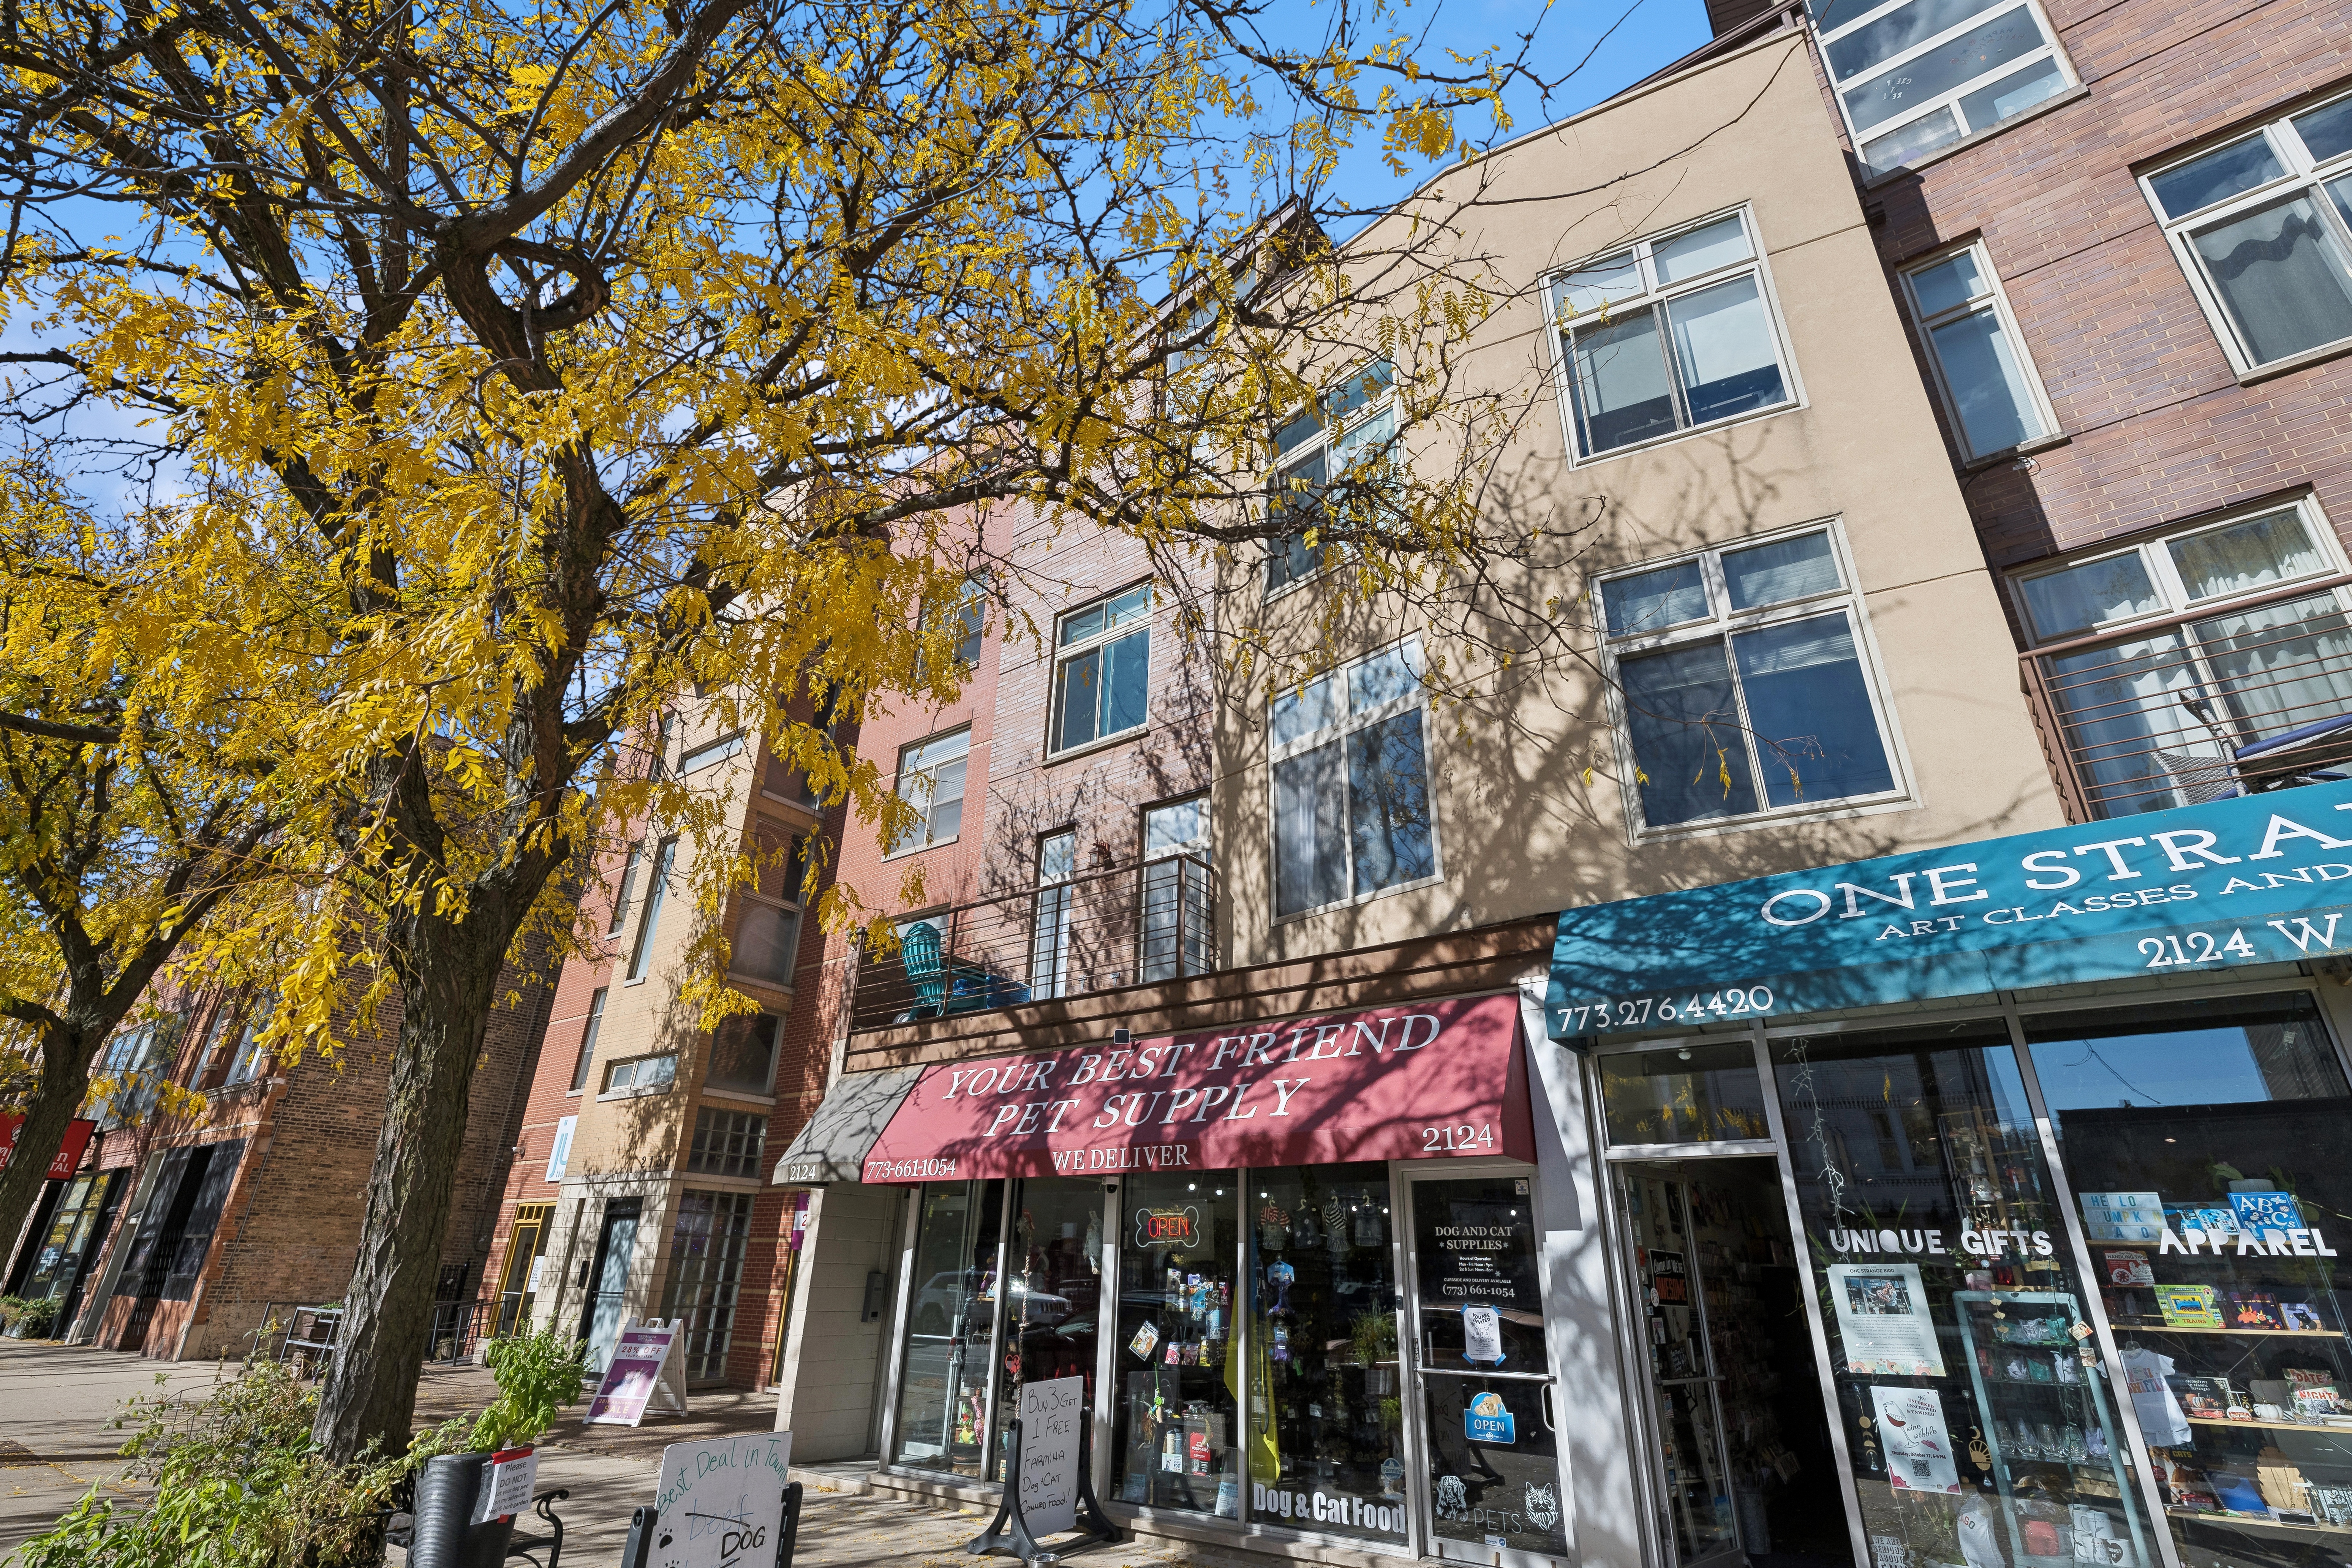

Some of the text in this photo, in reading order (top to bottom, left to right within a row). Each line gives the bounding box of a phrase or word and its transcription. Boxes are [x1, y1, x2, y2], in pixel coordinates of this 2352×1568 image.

[1761, 804, 2352, 926] ONE STRA
[1876, 863, 2352, 941] ART CLASSES AND
[2137, 913, 2343, 968] 2124 W
[1557, 985, 1773, 1033] 773.276.4420
[942, 1014, 1440, 1099] YOUR BEST FRIEND
[983, 1078, 1311, 1138] PET SUPPLY
[1422, 1124, 1494, 1152] 2124
[640, 1154, 671, 1169] 2130
[1052, 1144, 1190, 1171] WE DELIVER
[789, 1163, 816, 1181] 2124
[867, 1158, 956, 1181] 773-661-1054
[2090, 1195, 2136, 1207] HELO
[1149, 1217, 1189, 1237] OPEN
[1435, 1227, 1513, 1236] DOG AND CAT
[1447, 1240, 1502, 1250] SUPPLIES
[1829, 1229, 2053, 1256] UNIQUE GIFTS
[2159, 1228, 2337, 1257] APPAREL
[1654, 1259, 1666, 1273] Come
[1666, 1257, 1671, 1270] in
[1443, 1284, 1515, 1297] (773) 661-1054
[1656, 1277, 1687, 1301] AWESOME
[2297, 1374, 2323, 1385] DATE
[1048, 1386, 1060, 1410] 3
[1908, 1398, 1934, 1408] UNCORKED
[2299, 1391, 2333, 1400] NIGHT
[603, 1405, 629, 1414] SALE
[1906, 1404, 1936, 1413] UNSCREWED
[1033, 1414, 1070, 1439] 1 FREE
[1474, 1419, 1505, 1432] OPEN
[1914, 1426, 1937, 1439] wobble
[505, 1462, 527, 1473] Please
[499, 1473, 528, 1488] DO NOT
[658, 1439, 788, 1517] Best Deal in Town!
[508, 1491, 526, 1501] sidewalk
[513, 1500, 528, 1508] garden
[1254, 1483, 1406, 1534] Dog & Cat Food
[1474, 1508, 1521, 1533] PETS
[721, 1526, 765, 1560] DOG
[1872, 1544, 1905, 1555] SERIOUS
[1879, 1554, 1903, 1564] ABOUT
